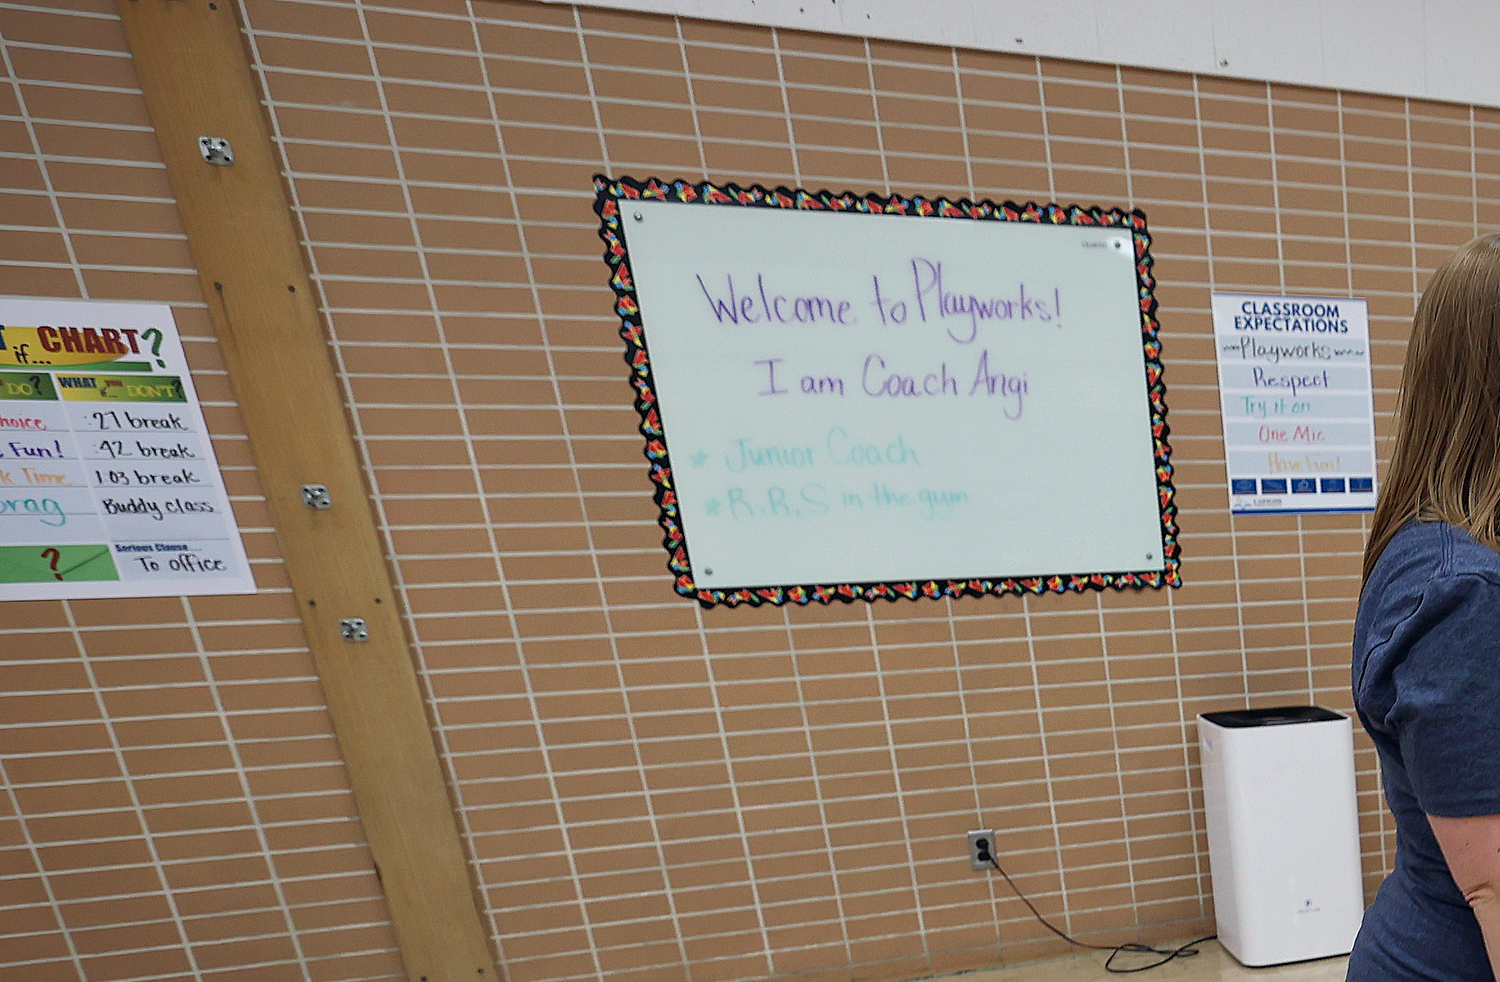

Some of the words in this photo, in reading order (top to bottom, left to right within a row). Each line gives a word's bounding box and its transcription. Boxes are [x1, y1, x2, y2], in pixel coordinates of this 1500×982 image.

[696, 272, 858, 325] Welcome
[871, 275, 907, 325] to
[911, 256, 1062, 344] Playworks!
[1241, 301, 1339, 319] CLASSROOM
[1234, 316, 1348, 334] EXPECTATIONS
[1240, 335, 1332, 364] Playworks
[754, 358, 789, 396] I
[800, 374, 844, 397] am
[862, 353, 958, 397] Coach
[969, 349, 1029, 421] Angi
[1252, 366, 1331, 397] Respect
[1241, 395, 1267, 418] Try
[1291, 402, 1311, 414] on
[124, 411, 189, 431] break
[1258, 425, 1288, 443] One
[1292, 425, 1325, 443] Mic
[8, 440, 64, 458] Fun!
[135, 440, 195, 458] break
[725, 437, 816, 473] Junior
[826, 426, 920, 466] Coach
[133, 468, 200, 486] break
[102, 497, 163, 521] Buddy
[165, 498, 214, 515] class
[841, 491, 863, 510] in
[871, 482, 908, 508] the
[917, 489, 969, 521] gym
[133, 555, 160, 572] To
[169, 553, 227, 573] office
